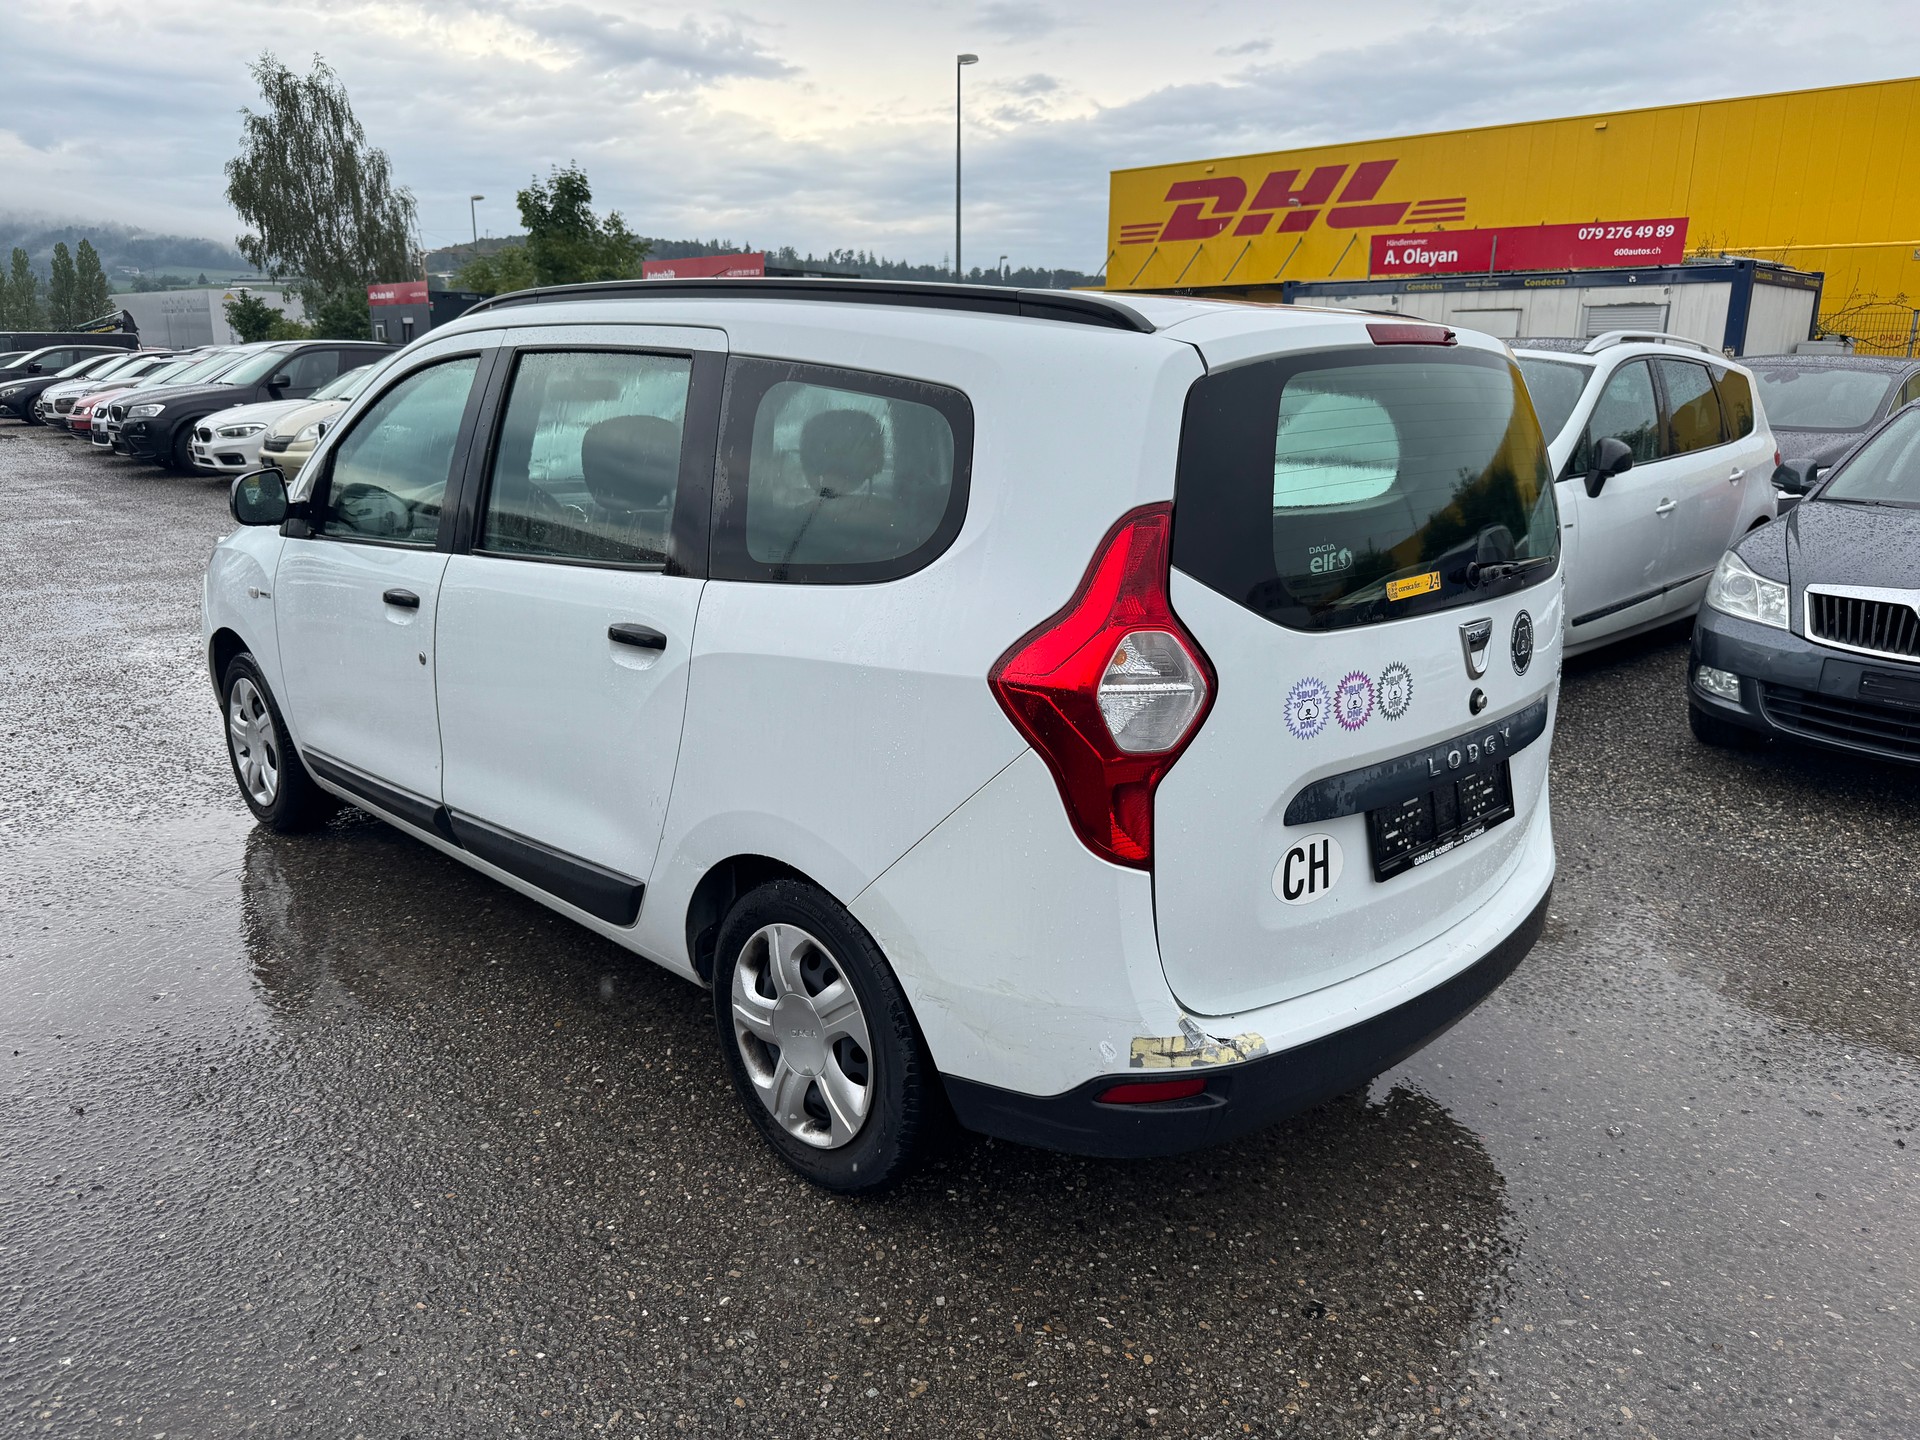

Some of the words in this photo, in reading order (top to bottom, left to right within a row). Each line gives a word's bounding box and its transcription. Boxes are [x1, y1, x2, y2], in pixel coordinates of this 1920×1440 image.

[1158, 159, 1412, 243] DHL
[1578, 227, 1604, 240] 079
[1606, 226, 1632, 239] 276
[1635, 225, 1654, 238] 49
[1655, 225, 1675, 237] 89
[1383, 249, 1400, 265] A.
[1403, 247, 1459, 268] Olayan
[1613, 246, 1662, 256] 600autos.ch
[1406, 283, 1442, 291] Condecta
[1524, 278, 1566, 287] Condecta
[1308, 543, 1336, 555] DACIA
[1310, 551, 1337, 573] elf
[1428, 572, 1440, 589] 24
[1296, 688, 1319, 700] SBUP
[1388, 697, 1403, 709] DNF
[1346, 707, 1363, 719] DNF
[1299, 719, 1317, 730] DNF
[1428, 727, 1510, 776] LODGY
[1414, 849, 1436, 866] GARAGE
[1435, 840, 1455, 856] ROBERT
[1282, 838, 1330, 901] CH
